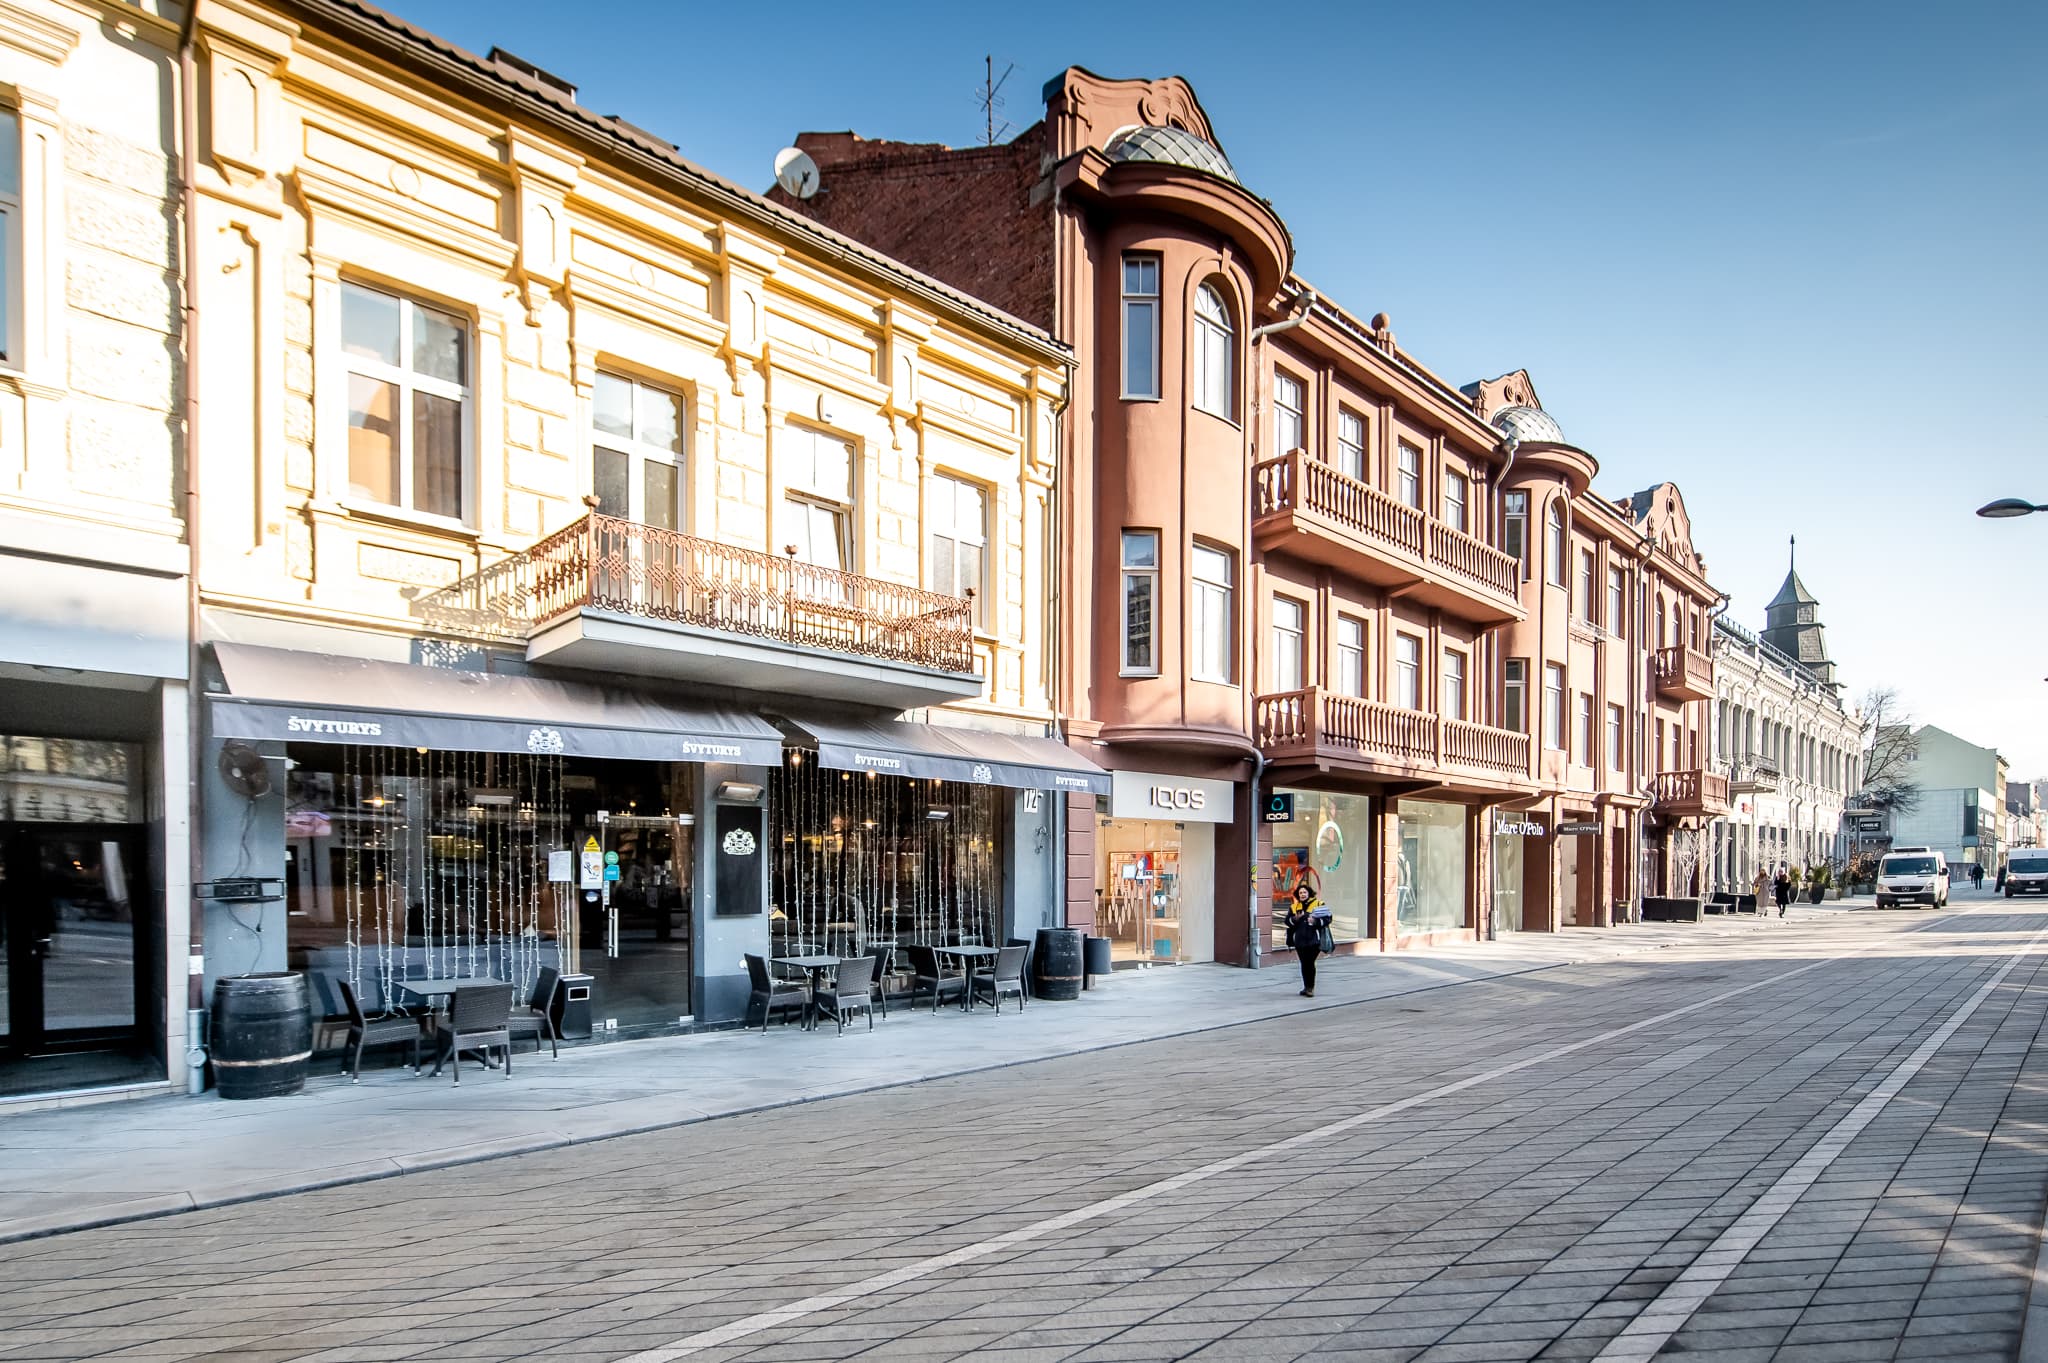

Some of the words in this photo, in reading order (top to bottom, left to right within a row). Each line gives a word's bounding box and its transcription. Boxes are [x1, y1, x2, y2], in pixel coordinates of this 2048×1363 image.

[288, 715, 382, 736] ŠVYTURYS
[1150, 786, 1206, 810] IQOS
[1265, 811, 1289, 822] IQOS
[1495, 820, 1519, 836] Marc
[1519, 821, 1544, 836] O'Polo
